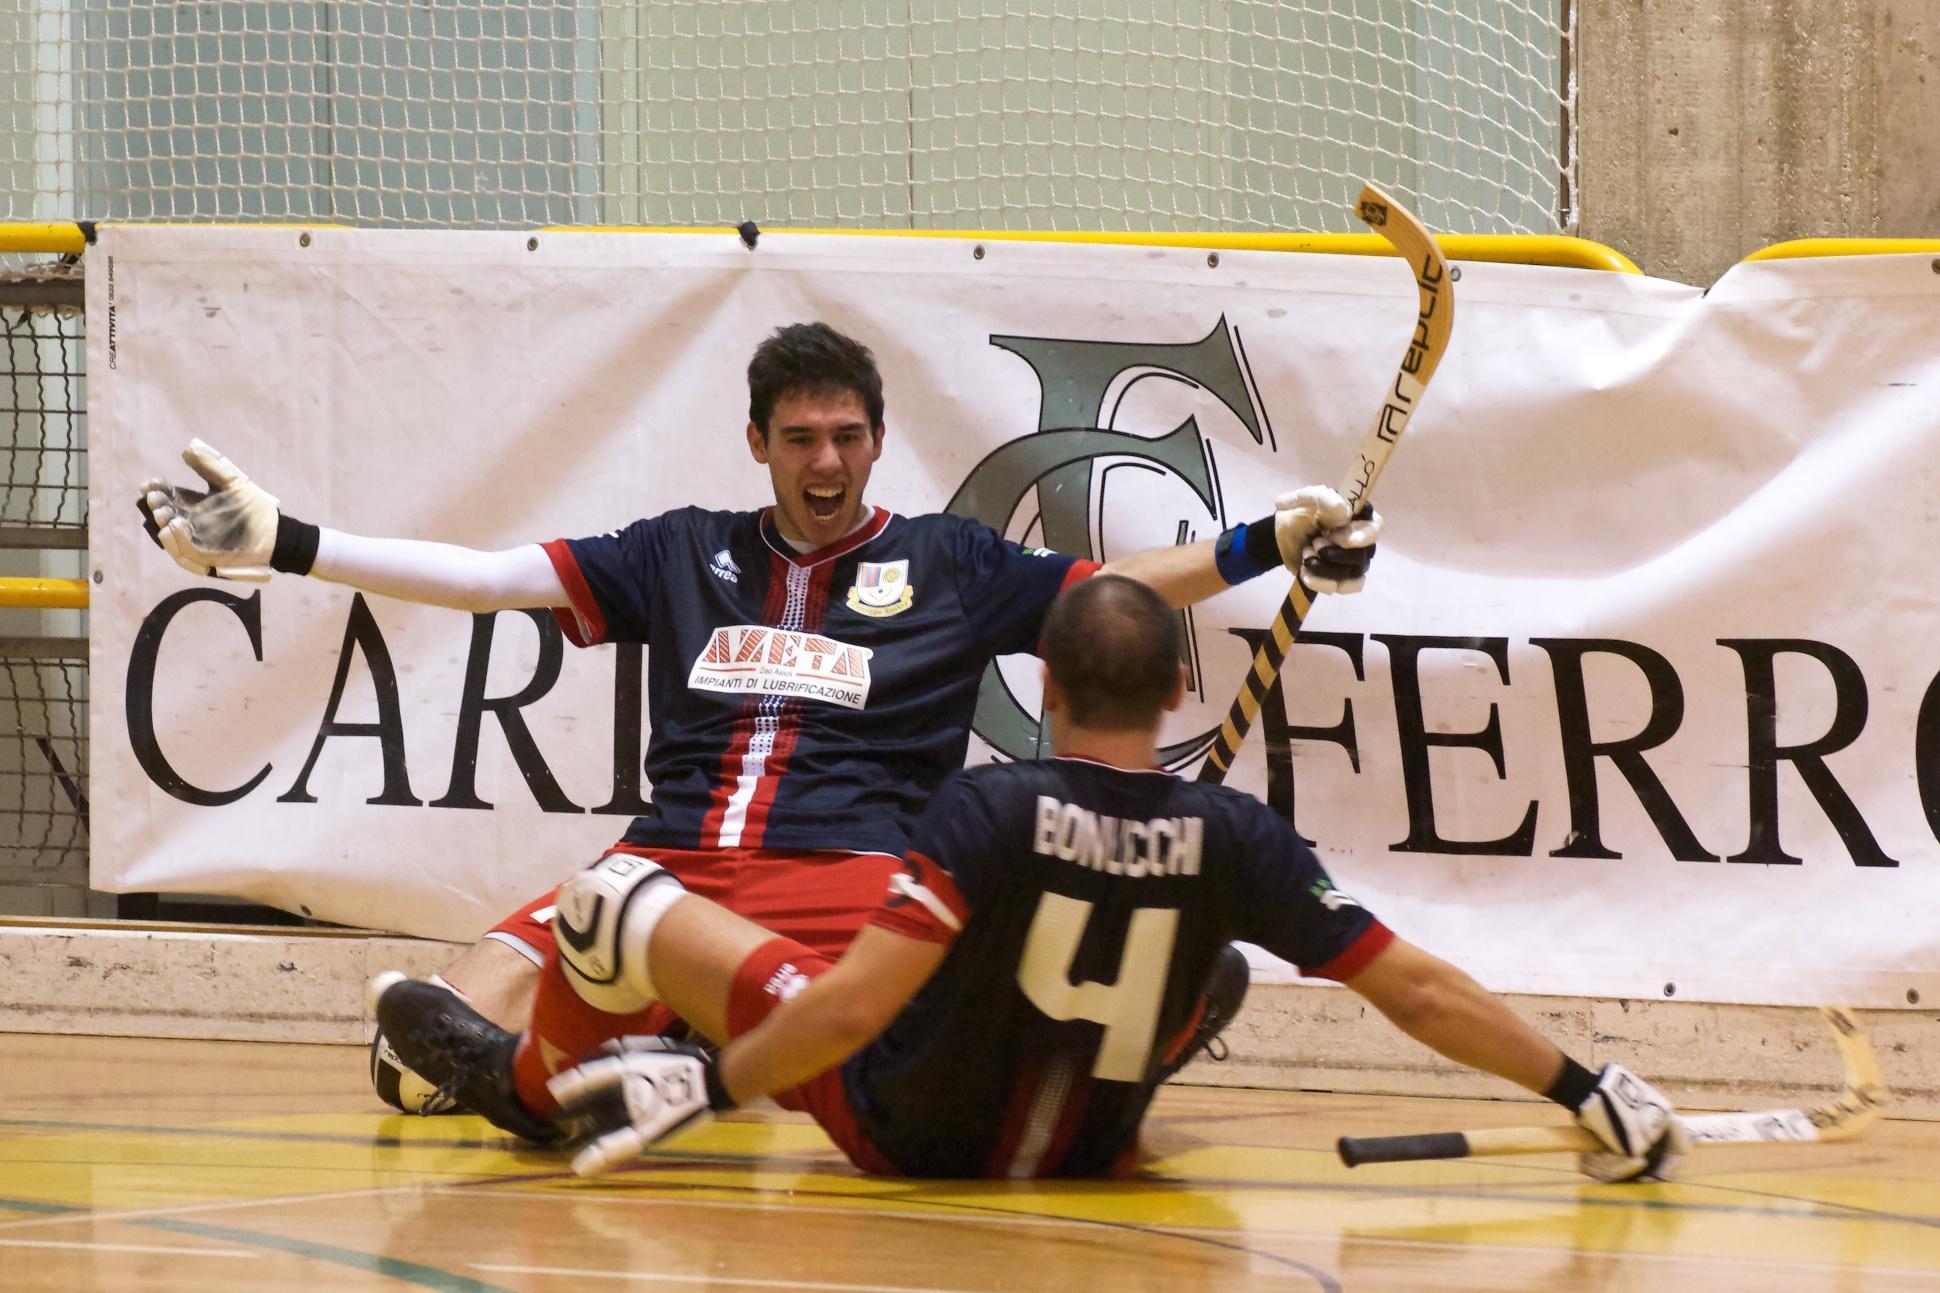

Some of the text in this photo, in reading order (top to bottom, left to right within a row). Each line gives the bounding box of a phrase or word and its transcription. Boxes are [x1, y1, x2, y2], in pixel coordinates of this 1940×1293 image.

[694, 674, 862, 705] IMPIANTI DI LUBRIFICAZIONE
[1228, 627, 1940, 868] FERR
[1016, 890, 1181, 1083] 4
